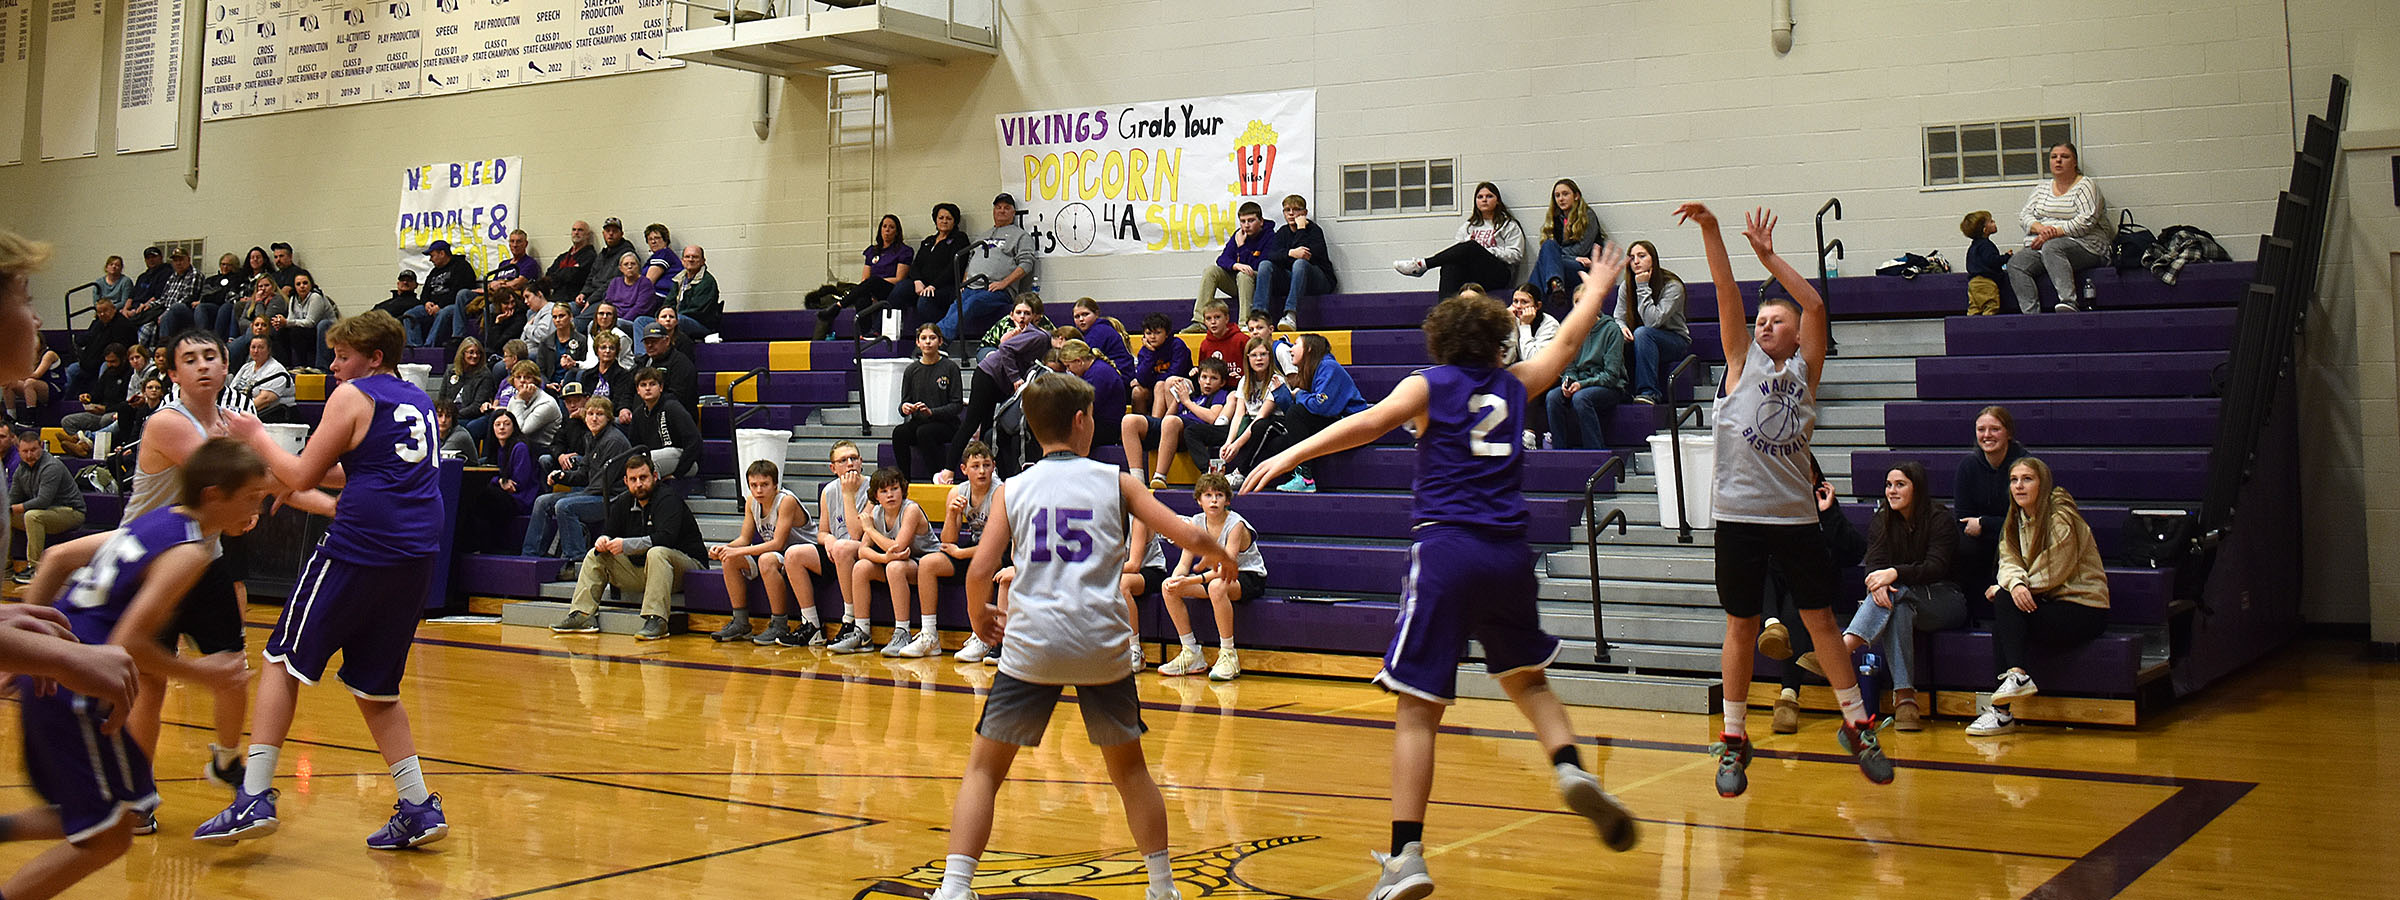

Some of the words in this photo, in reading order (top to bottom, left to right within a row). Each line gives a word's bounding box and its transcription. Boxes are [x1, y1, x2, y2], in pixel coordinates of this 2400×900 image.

[536, 10, 560, 22] SPEECH
[581, 6, 624, 20] PRODUCTION
[474, 21, 486, 30] PLAY
[487, 16, 520, 28] PRODUCTION
[644, 18, 661, 29] CLASS
[378, 34, 389, 44] PLAY
[390, 29, 420, 42] PRODUCTION
[436, 25, 458, 37] SPEECH
[589, 26, 606, 36] CLASS
[606, 25, 614, 34] D1
[630, 31, 647, 41] STATE
[336, 30, 371, 44] ALL-ACTIVITIES
[535, 34, 552, 43] CLASS
[552, 32, 560, 40] D1
[576, 38, 592, 48] STATE
[593, 33, 626, 46] CHAMPIONS
[257, 45, 274, 55] CROSS
[289, 46, 300, 55] PLAY
[300, 42, 328, 54] PRODUCTION
[348, 43, 357, 53] CUP
[485, 41, 500, 49] CLASS
[523, 45, 539, 55] STATE
[540, 40, 572, 52] CHAMPIONS
[387, 53, 401, 62] CLASS
[435, 48, 450, 56] CLASS
[450, 47, 457, 55] D1
[472, 52, 487, 61] STATE
[488, 47, 520, 59] CHAMPIONS
[211, 55, 236, 67] BASEBALL
[253, 55, 277, 66] COUNTRY
[343, 59, 356, 68] CLASS
[375, 64, 389, 73] STATE
[390, 60, 419, 71] CHAMPIONS
[423, 58, 438, 68] STATE
[438, 55, 469, 67] RUNNER-UP
[602, 57, 616, 66] 2022
[297, 64, 311, 73] CLASS
[331, 70, 345, 79] GIRLS
[345, 66, 373, 77] RUNNER-UP
[548, 63, 562, 72] 2022
[214, 75, 227, 84] CLASS
[256, 70, 268, 78] CLASS
[286, 75, 300, 84] STATE
[300, 71, 327, 83] RUNNER-UP
[496, 70, 509, 78] 2021
[245, 80, 257, 89] STATE
[258, 77, 284, 88] RUNNER-UP
[398, 81, 410, 90] 2020
[446, 76, 459, 85] 2021
[204, 86, 216, 94] STATE
[216, 82, 242, 93] RUNNER-UP
[341, 88, 360, 97] 2019-20
[264, 97, 276, 106] 2019
[307, 92, 319, 100] 2019
[1001, 110, 1109, 146] VIKINGS
[1118, 106, 1177, 139] Grab
[1181, 104, 1224, 138] Your
[407, 165, 432, 191] WE
[450, 158, 506, 188] BLEED
[1024, 147, 1182, 202] POPCORN
[400, 207, 484, 249] PURPLE
[488, 204, 508, 240] &
[1145, 201, 1237, 251] SHOW
[1758, 378, 1804, 400] WAUSA
[1467, 394, 1512, 456] 2
[393, 403, 439, 468] 31
[1742, 426, 1808, 457] BASKETBALL
[1031, 507, 1093, 563] 15
